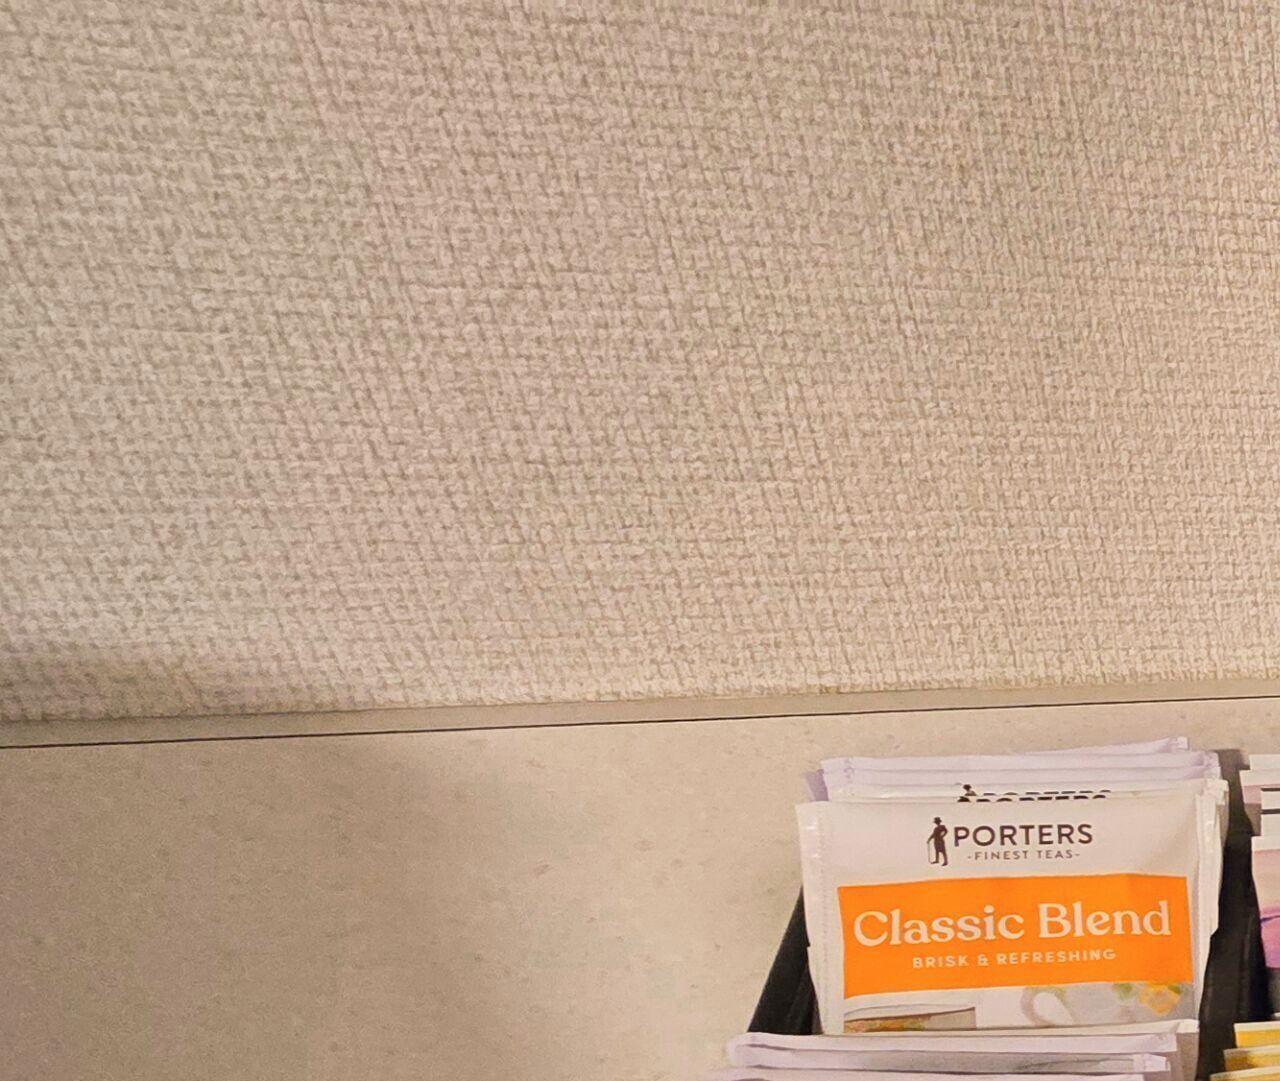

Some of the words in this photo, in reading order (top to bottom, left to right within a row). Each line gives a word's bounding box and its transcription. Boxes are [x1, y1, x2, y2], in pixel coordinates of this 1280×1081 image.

[954, 823, 1093, 847] PORTERS
[853, 904, 1025, 947] Classic
[1038, 900, 1172, 939] Blend
[912, 954, 969, 969] BRISK
[977, 953, 989, 967] &
[997, 949, 1116, 965] REFRESHING
